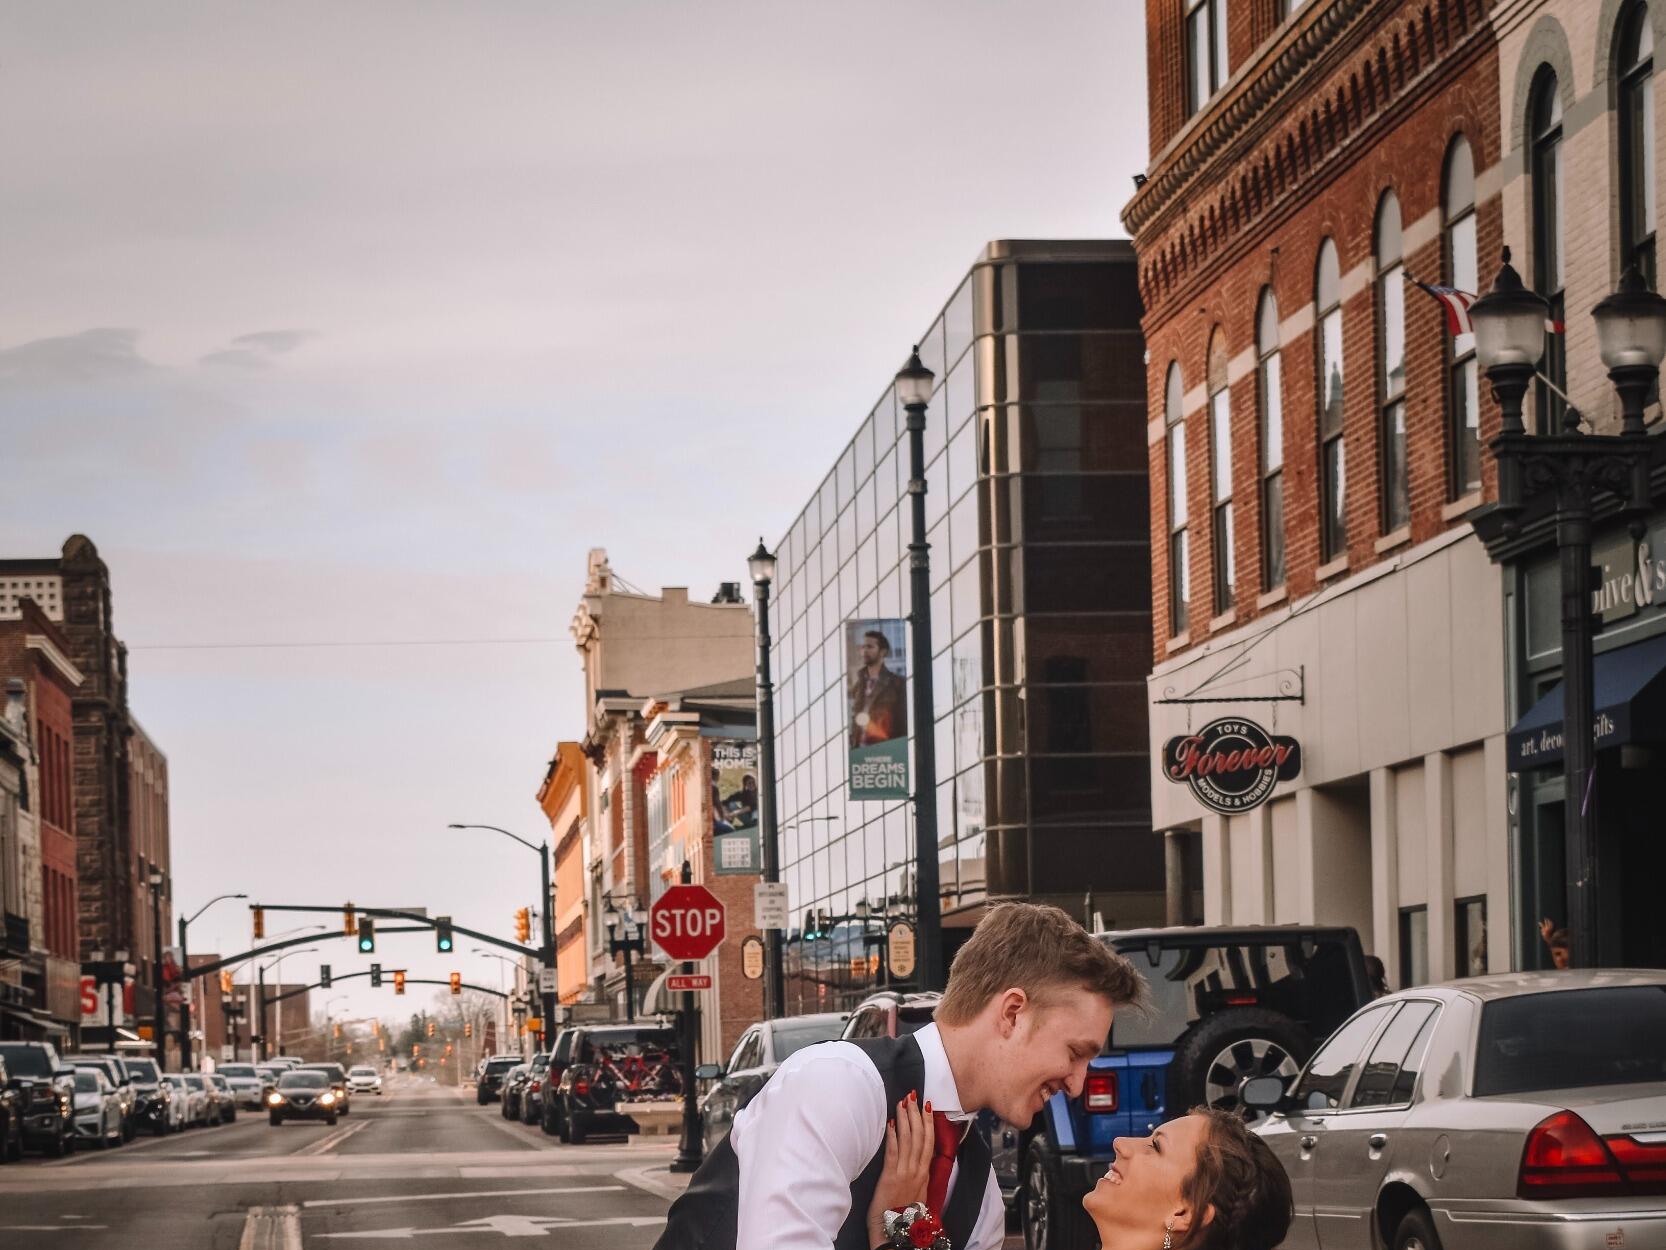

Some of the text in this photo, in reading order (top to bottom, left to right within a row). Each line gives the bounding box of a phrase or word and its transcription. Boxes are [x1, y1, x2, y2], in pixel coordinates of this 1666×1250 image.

[1216, 725, 1248, 735] TOYS
[713, 747, 753, 758] THIS IS
[1170, 735, 1294, 779] Forever
[714, 758, 754, 769] HOME
[851, 763, 905, 774] DREAMS
[852, 774, 905, 788] BEGIN
[1197, 778, 1231, 806] MODELS
[1242, 769, 1273, 804] HOBBIES
[655, 908, 721, 937] STOP
[670, 977, 708, 988] ALL WAY
